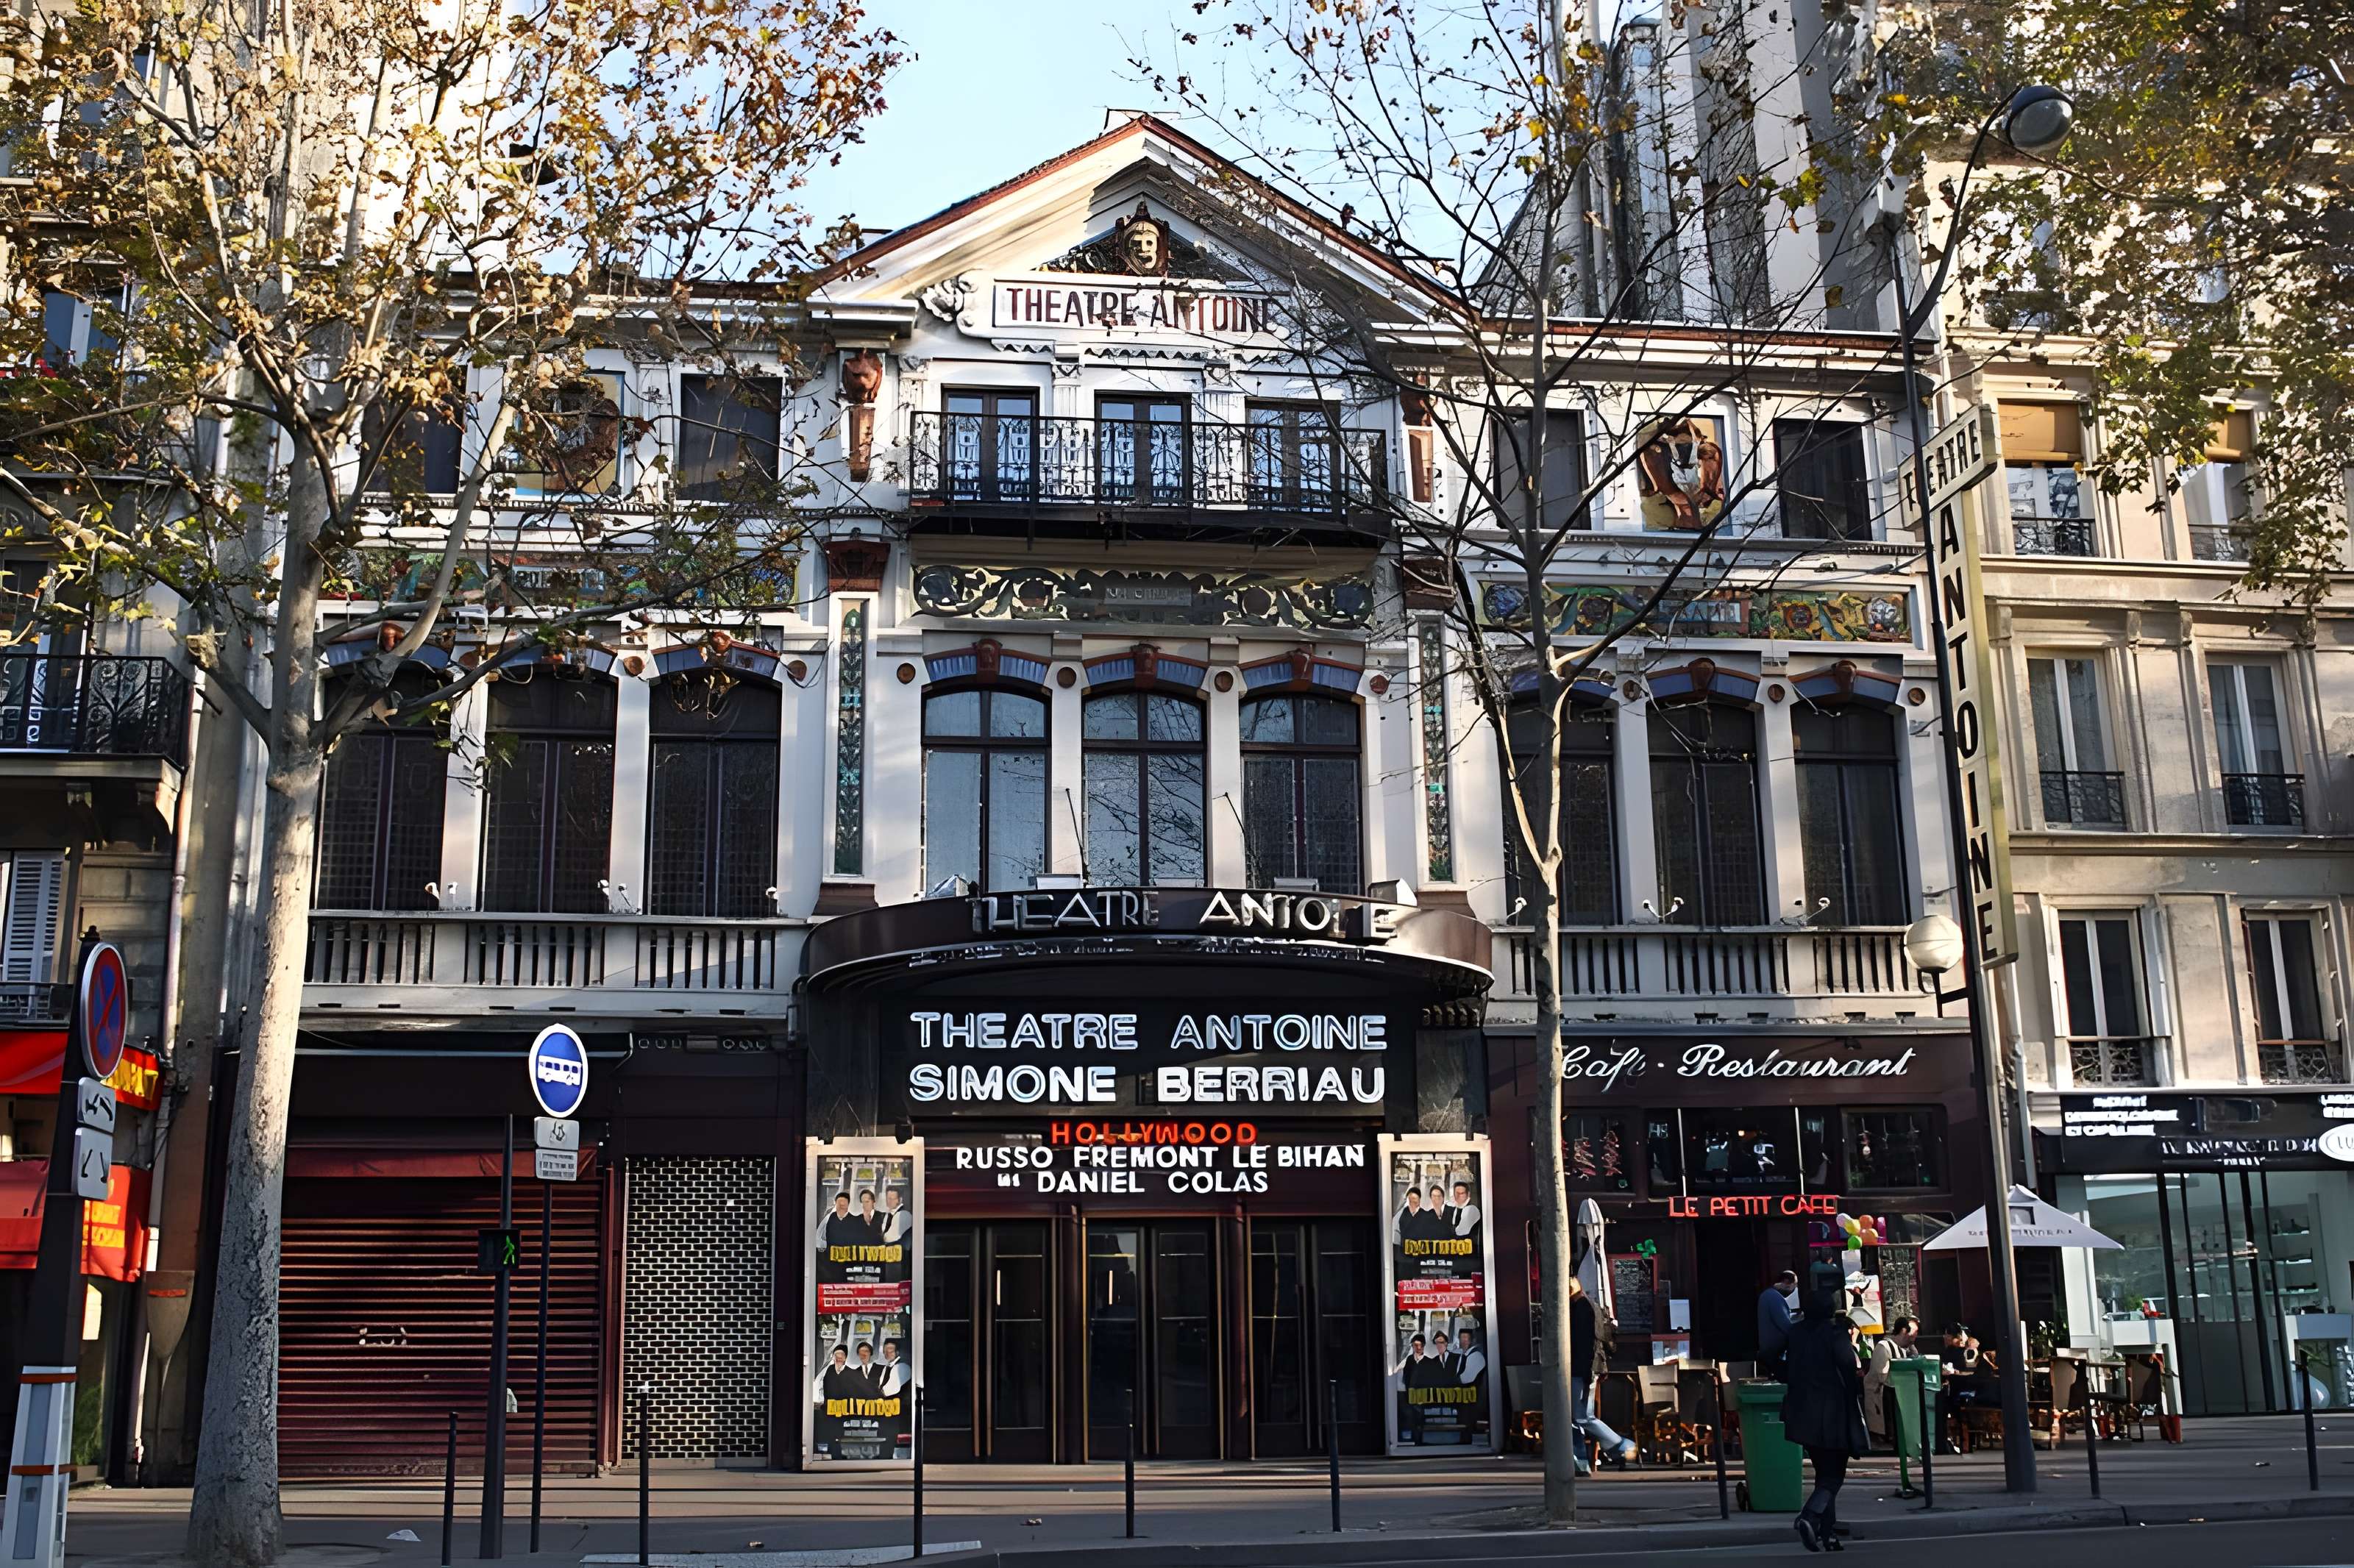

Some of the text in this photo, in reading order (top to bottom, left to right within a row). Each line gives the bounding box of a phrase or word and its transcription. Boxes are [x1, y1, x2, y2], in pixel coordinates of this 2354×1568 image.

[1006, 288, 1137, 326] THEATRE
[1903, 418, 1981, 512] TEATRE
[1940, 503, 1998, 962] ANTOINE
[909, 1012, 1387, 1050] THEATRE ANTOINE
[1677, 1044, 1916, 1077] Restaurant
[909, 1063, 1385, 1102] SIMONE BERRIAU
[1051, 1122, 1257, 1144] HOLLYWOOD
[956, 1145, 1365, 1169] RUSSO FREMONT LE BIHAN
[1037, 1172, 1145, 1193] DANIEL
[1168, 1172, 1268, 1193] COLAS
[1668, 1196, 1699, 1217] LE
[1710, 1196, 1771, 1216] PETIT
